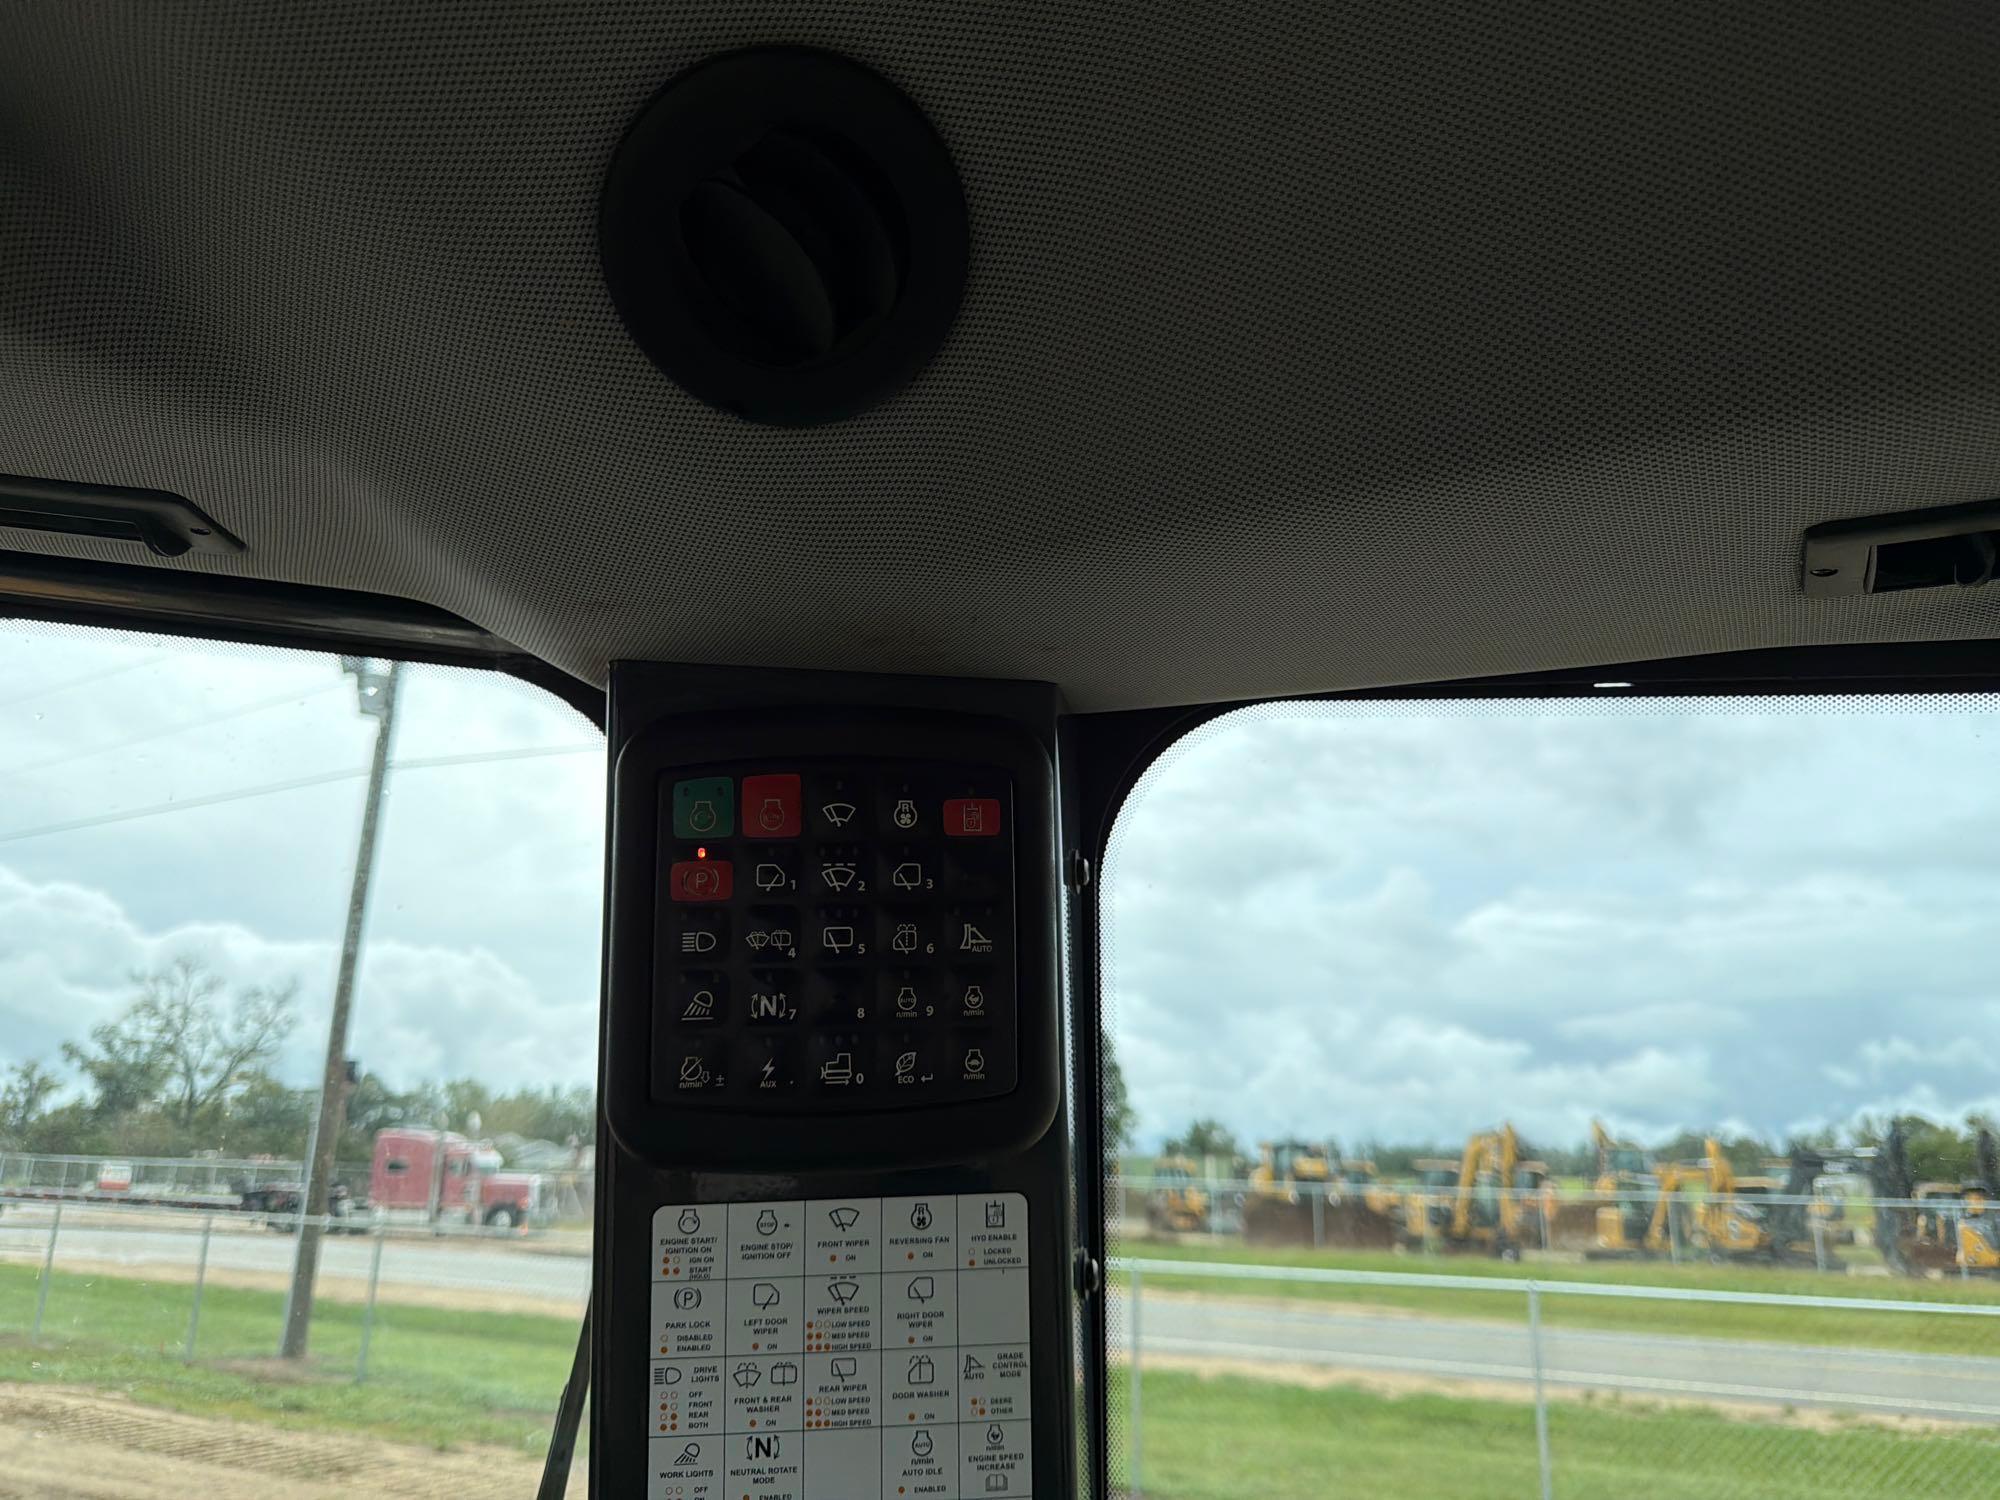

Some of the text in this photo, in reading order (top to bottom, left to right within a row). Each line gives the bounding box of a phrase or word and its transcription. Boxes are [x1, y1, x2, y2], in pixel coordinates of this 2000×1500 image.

[902, 804, 909, 812] R
[697, 873, 708, 889] P
[790, 880, 796, 890] 1
[926, 879, 934, 889] 3
[858, 881, 865, 891] 2
[788, 948, 796, 958] 4
[858, 944, 865, 954] 5
[927, 944, 934, 954] 6
[972, 945, 992, 953] AUTO
[760, 995, 777, 1016] N
[789, 1009, 797, 1020] 7
[857, 1008, 865, 1019] 8
[896, 1010, 918, 1018] n/min
[926, 1006, 934, 1016] 9
[856, 1073, 864, 1084] 0
[898, 1076, 915, 1084] ECO
[890, 1237, 932, 1245] REVERSING
[971, 1233, 1017, 1242] HYD ENABLE
[660, 1238, 689, 1246] ENGINE
[818, 1239, 870, 1248] FRONT WIPER
[665, 1247, 699, 1255] IGNITION
[741, 1243, 768, 1251] ENGINE
[742, 1251, 792, 1260] IGNITION OFF
[984, 1257, 1021, 1265] UNLOCKED
[689, 1266, 712, 1274] START
[684, 1291, 694, 1306] P
[817, 1306, 870, 1314] WIPER SPEED
[897, 1312, 920, 1320] RIGHT
[665, 1321, 687, 1329] PARK
[744, 1318, 763, 1326] LEFT
[832, 1320, 847, 1328] LOW
[677, 1344, 711, 1352] ENABLED
[997, 1352, 1024, 1360] GRADE
[992, 1361, 1028, 1369] CONTROL
[694, 1366, 718, 1374] DRIVE
[1000, 1370, 1021, 1378] MODE
[691, 1375, 720, 1383] LIGHTS
[964, 1372, 985, 1380] AUTO
[819, 1384, 868, 1393] REAR WIPER
[892, 1391, 950, 1400] DOOR WASHER
[734, 1397, 761, 1405] FRONT
[771, 1395, 792, 1403] REAR
[832, 1397, 847, 1405] LOW
[746, 1405, 780, 1413] WASHER
[832, 1408, 846, 1416] MED
[991, 1407, 1013, 1415] OTHER
[688, 1411, 709, 1419] REAR
[755, 1437, 772, 1459] N
[911, 1457, 934, 1465] n/min
[968, 1453, 1024, 1462] ENGINE SPEED
[977, 1462, 1015, 1471] INCREASE
[660, 1470, 714, 1479] WORK LIGHTS
[730, 1466, 798, 1476] NEUTRAL ROTATE
[902, 1467, 943, 1476] AUTO IDLE
[753, 1477, 775, 1485] MODE
